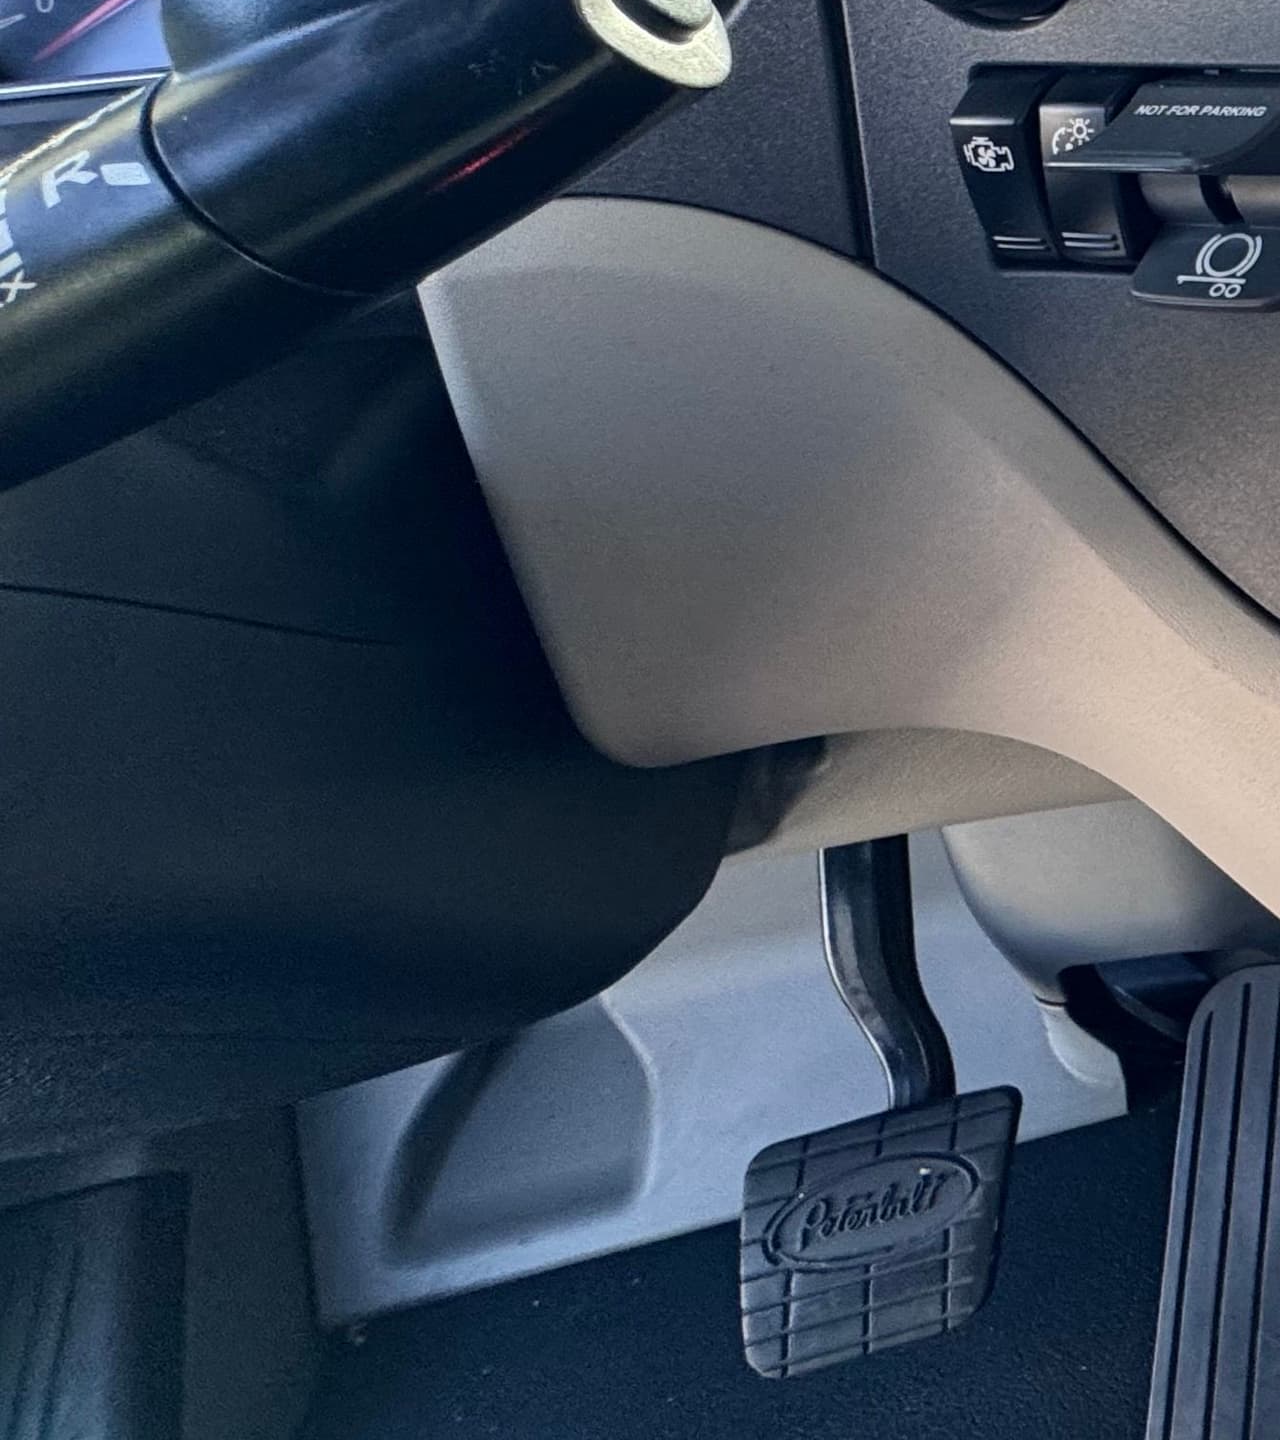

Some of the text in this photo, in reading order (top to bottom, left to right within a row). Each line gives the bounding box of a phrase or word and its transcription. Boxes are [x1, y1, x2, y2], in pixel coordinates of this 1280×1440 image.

[1133, 105, 1267, 117] NOT FOR PARKING
[41, 150, 99, 209] R
[797, 1170, 948, 1252] Peterbilt
